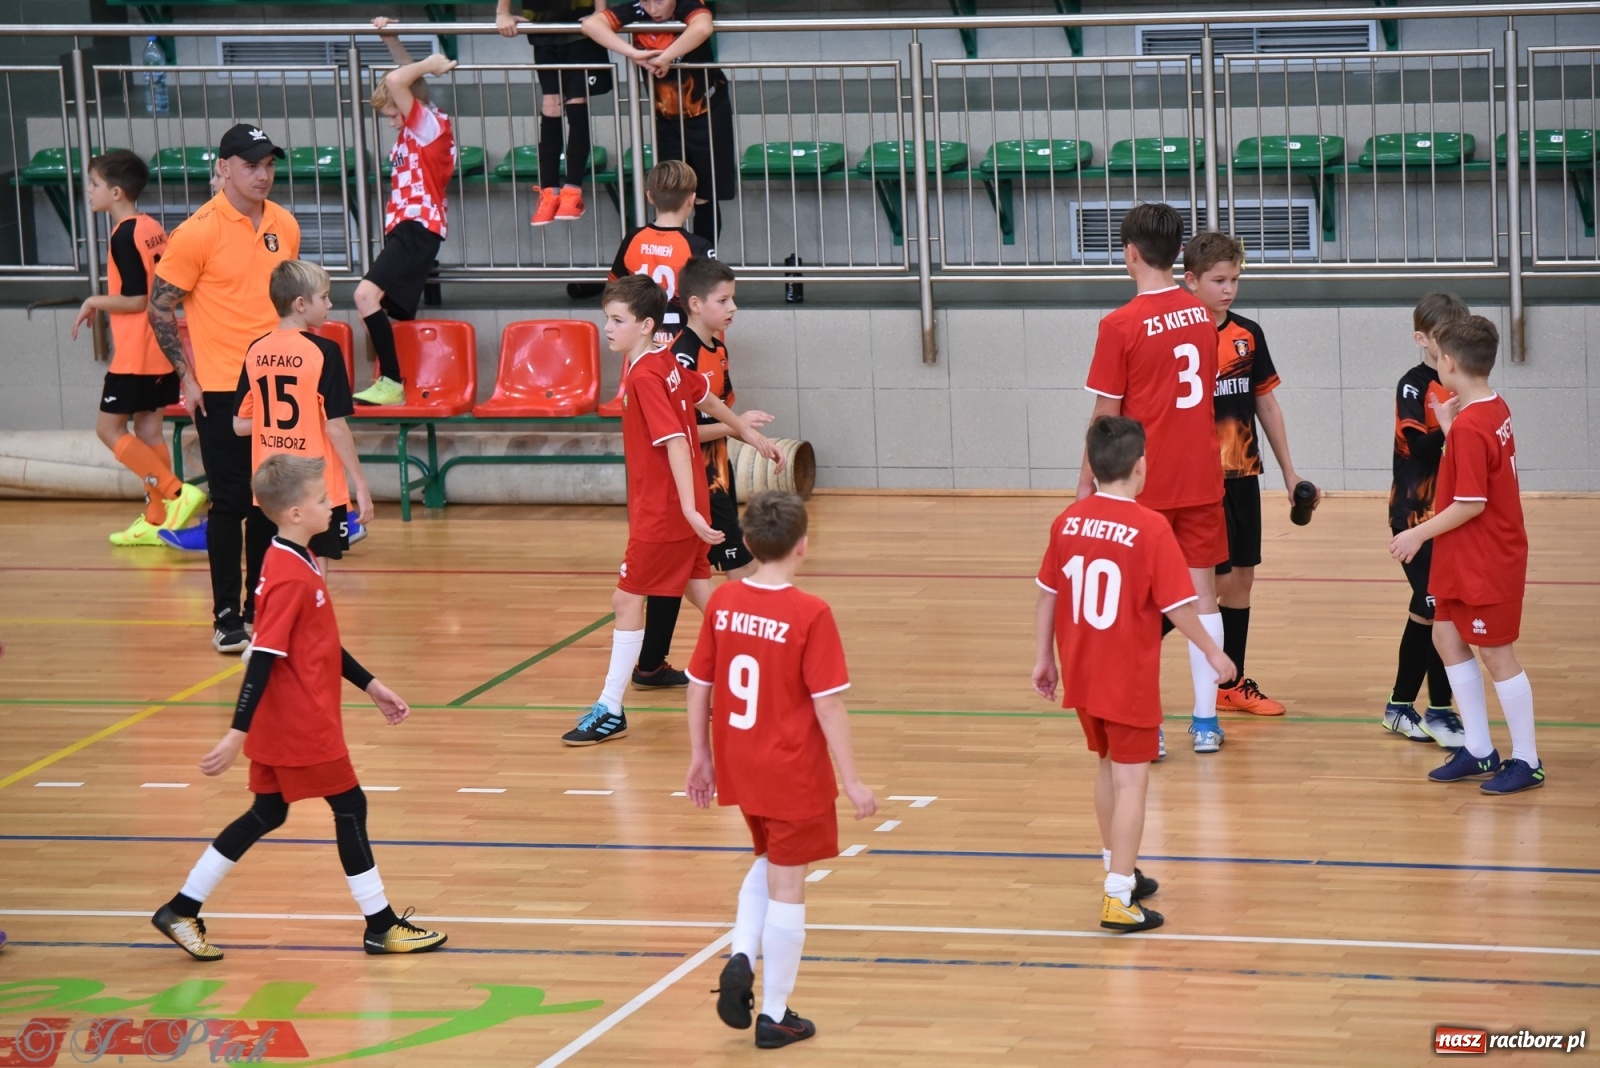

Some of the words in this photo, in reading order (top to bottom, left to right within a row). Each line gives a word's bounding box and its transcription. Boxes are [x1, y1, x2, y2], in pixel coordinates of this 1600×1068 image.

[1143, 315, 1164, 337] ZS
[1163, 306, 1210, 331] KIETRZ
[256, 354, 303, 368] RAFAKO
[1173, 343, 1204, 409] 3
[256, 375, 300, 430] 15
[1062, 517, 1081, 535] ZS
[1081, 518, 1139, 548] KIETRZ
[1061, 554, 1122, 630] 10
[731, 611, 790, 643] KIETRZ
[728, 653, 760, 730] 9
